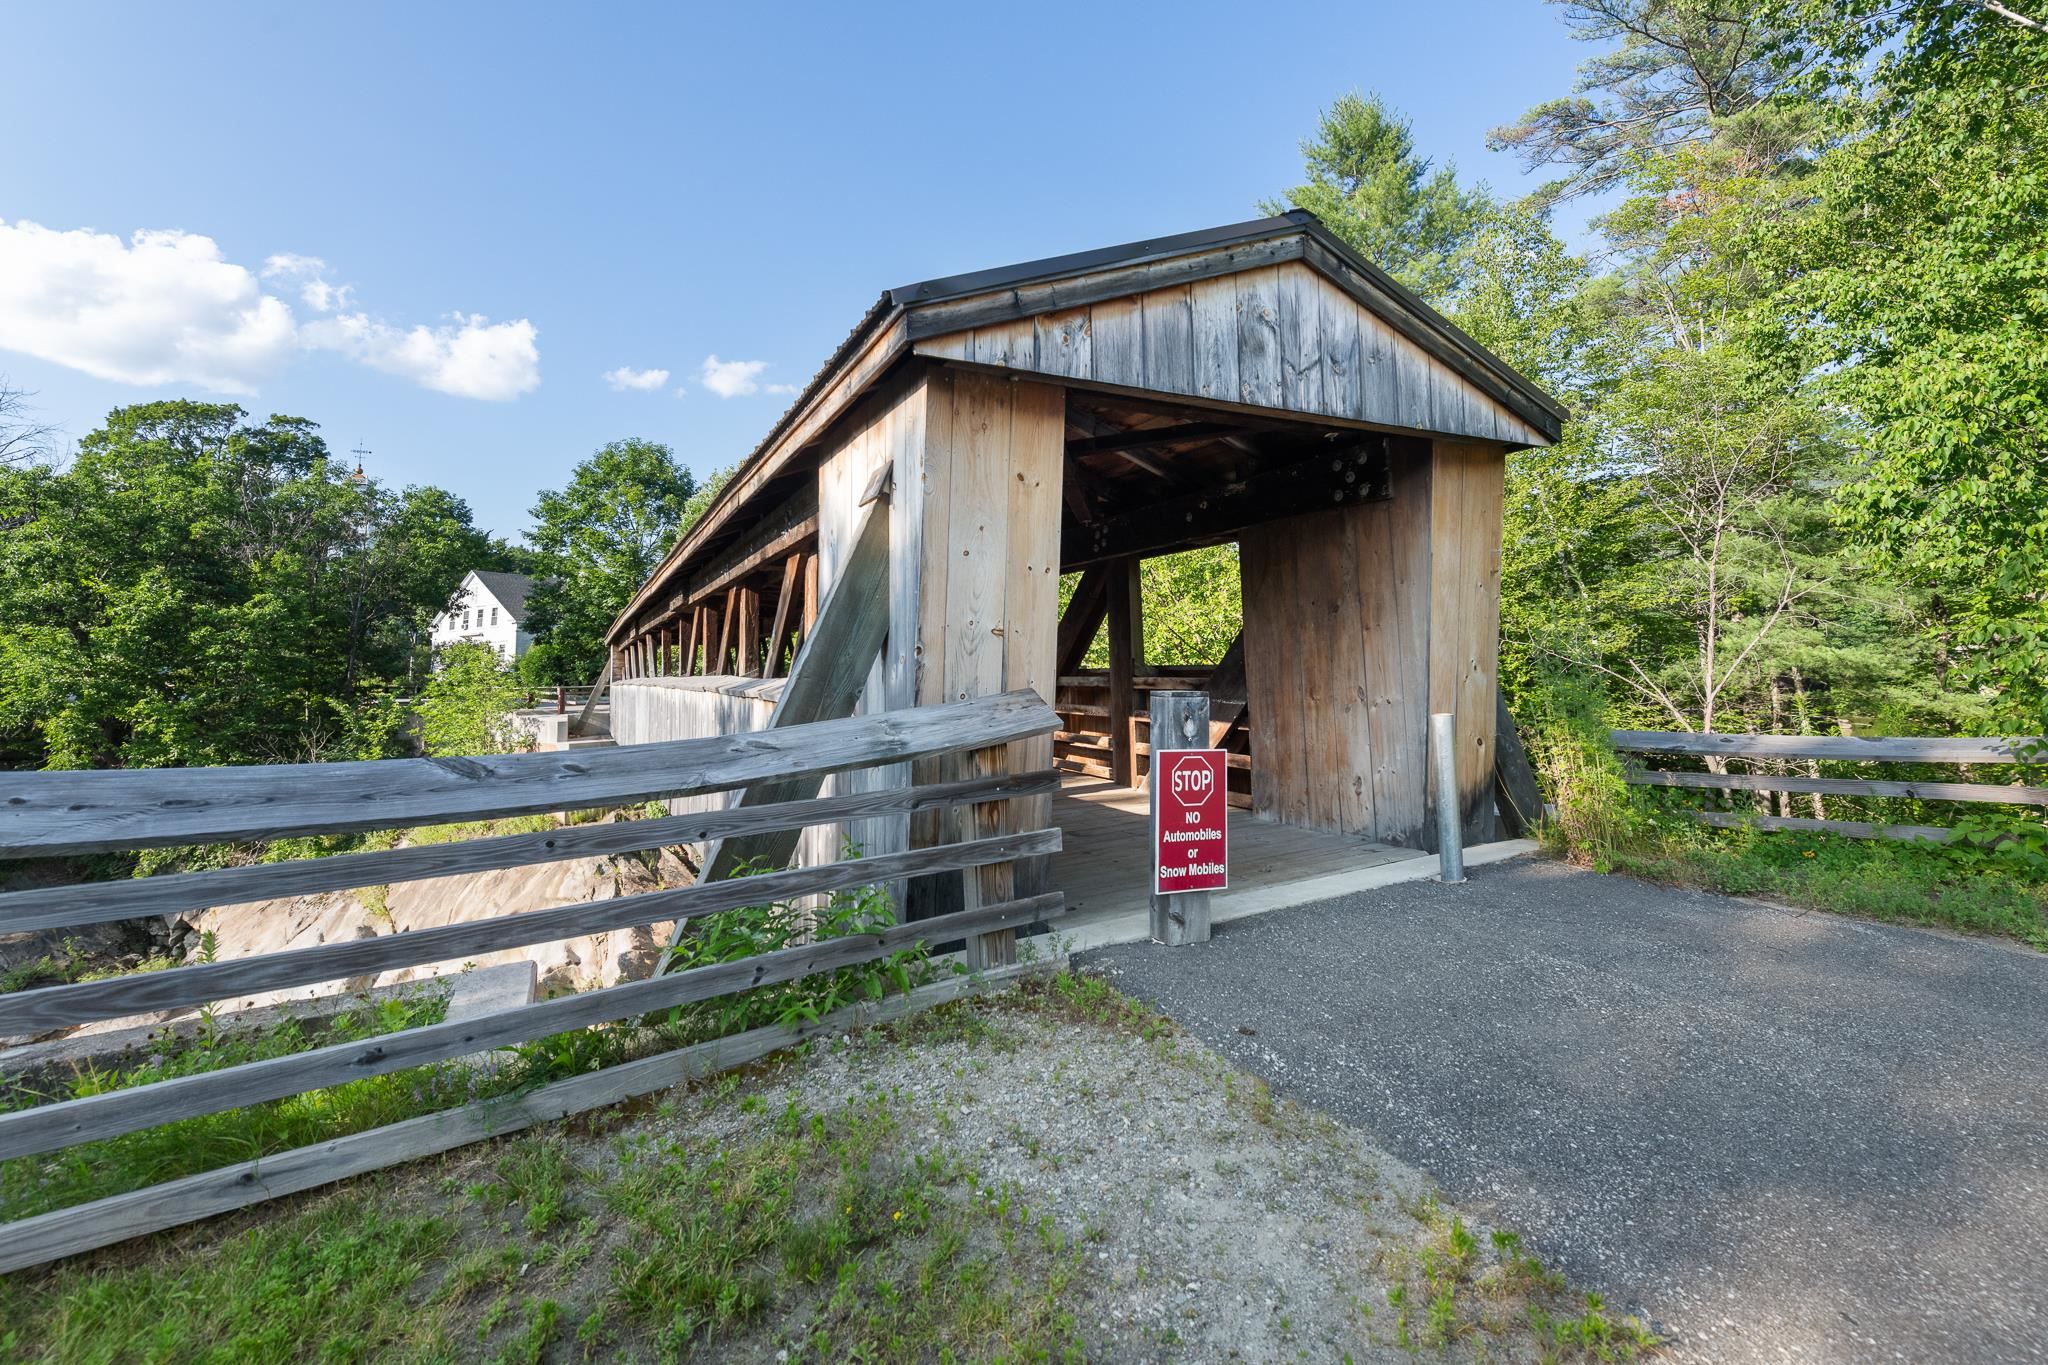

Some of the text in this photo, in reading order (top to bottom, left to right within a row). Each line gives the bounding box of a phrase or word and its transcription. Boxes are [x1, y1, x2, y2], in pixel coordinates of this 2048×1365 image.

[1174, 769, 1211, 792] STOP
[1185, 811, 1201, 824] NO
[1163, 828, 1222, 843] Automobiles
[1187, 848, 1199, 858] or
[1160, 863, 1225, 878] Snow Mobiles
